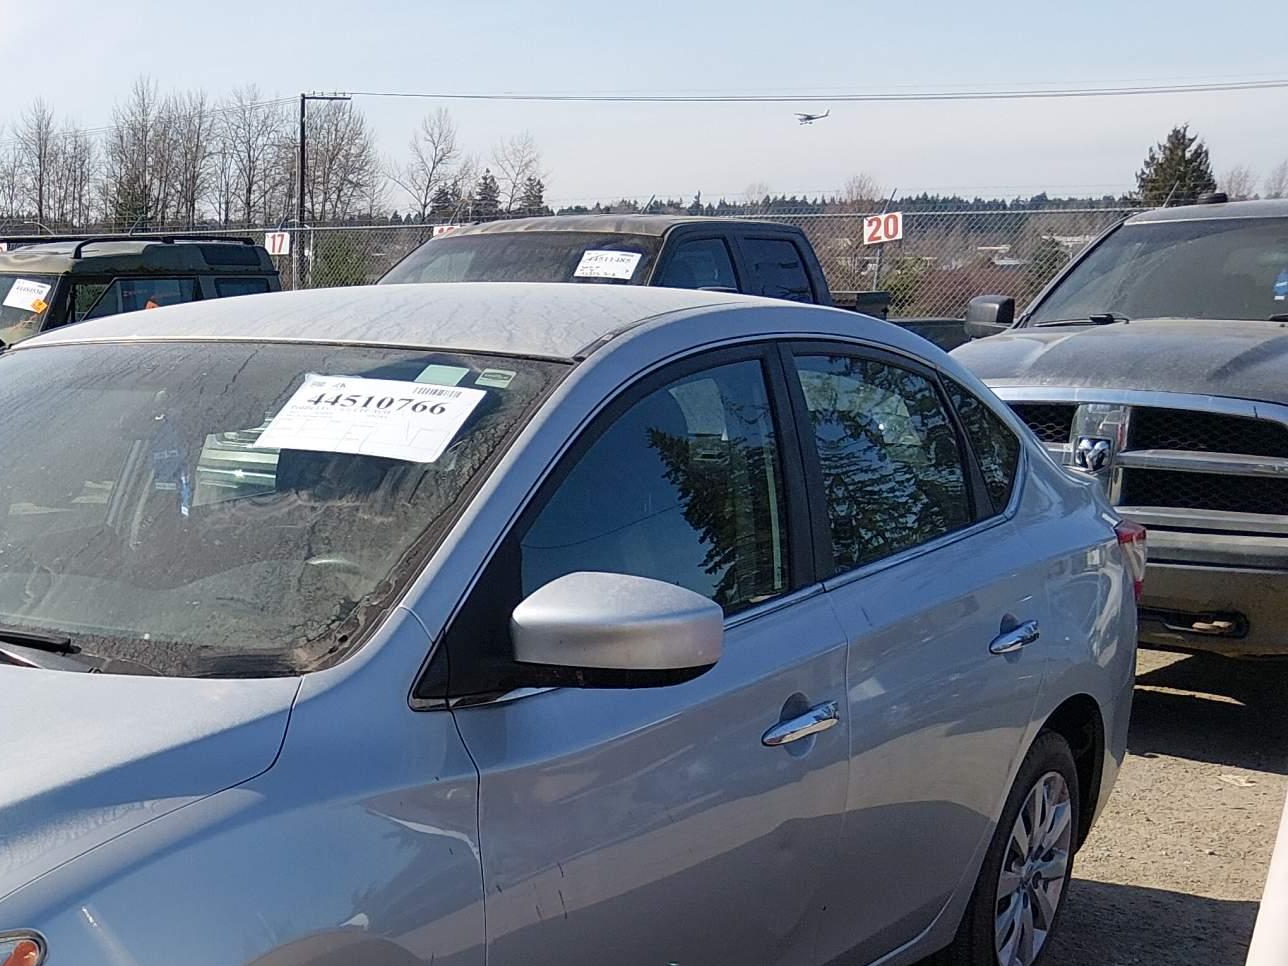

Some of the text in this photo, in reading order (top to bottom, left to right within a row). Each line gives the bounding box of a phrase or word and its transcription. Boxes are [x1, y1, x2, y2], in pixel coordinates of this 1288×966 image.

[867, 214, 899, 242] 20
[270, 233, 285, 254] 17
[307, 392, 447, 415] 44510766
